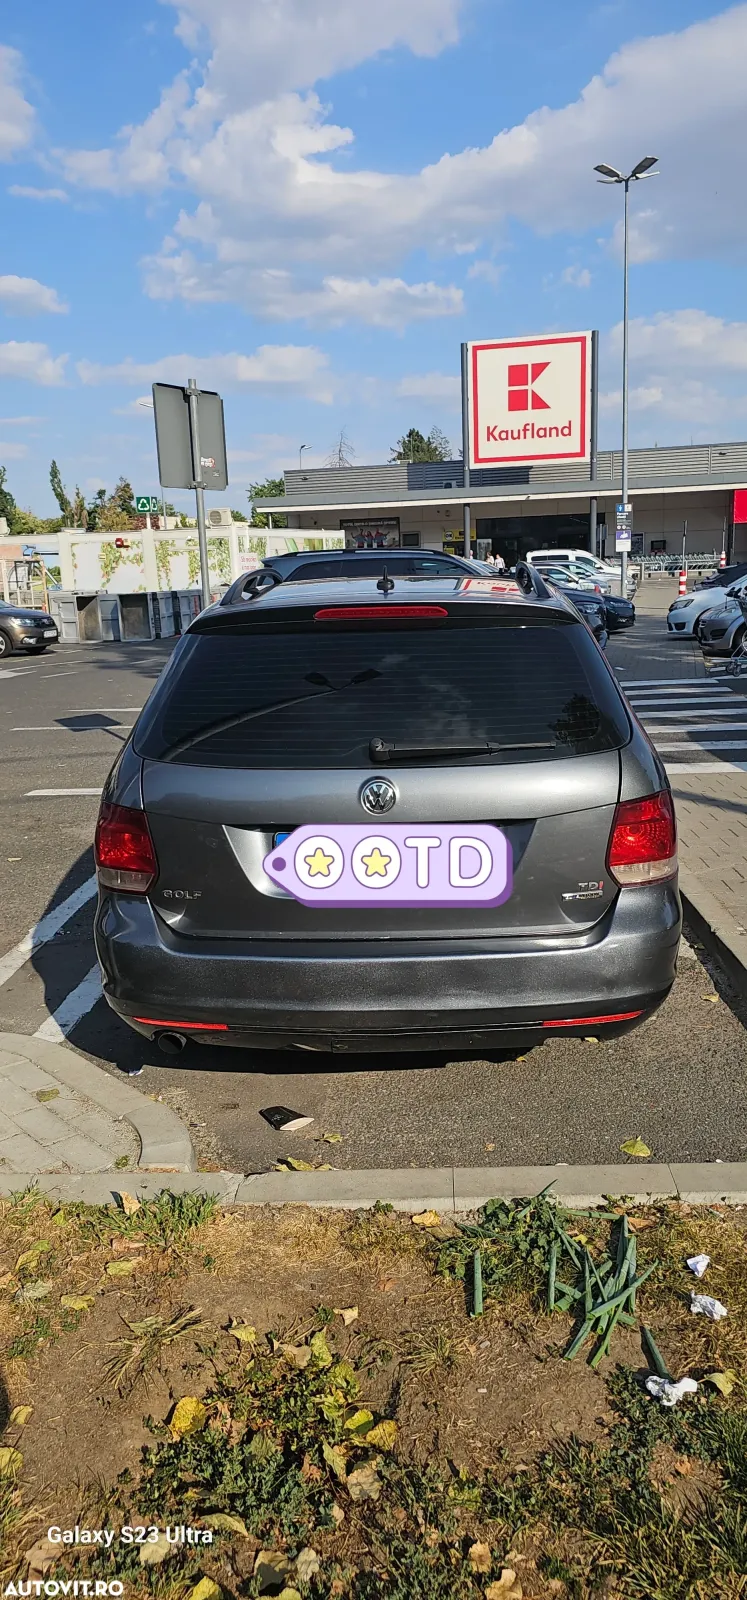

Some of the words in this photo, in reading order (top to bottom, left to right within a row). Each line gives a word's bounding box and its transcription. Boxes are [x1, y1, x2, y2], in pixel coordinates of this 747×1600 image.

[486, 420, 572, 442] Kaufland
[578, 880, 604, 891] TDI
[162, 889, 202, 900] GOLF
